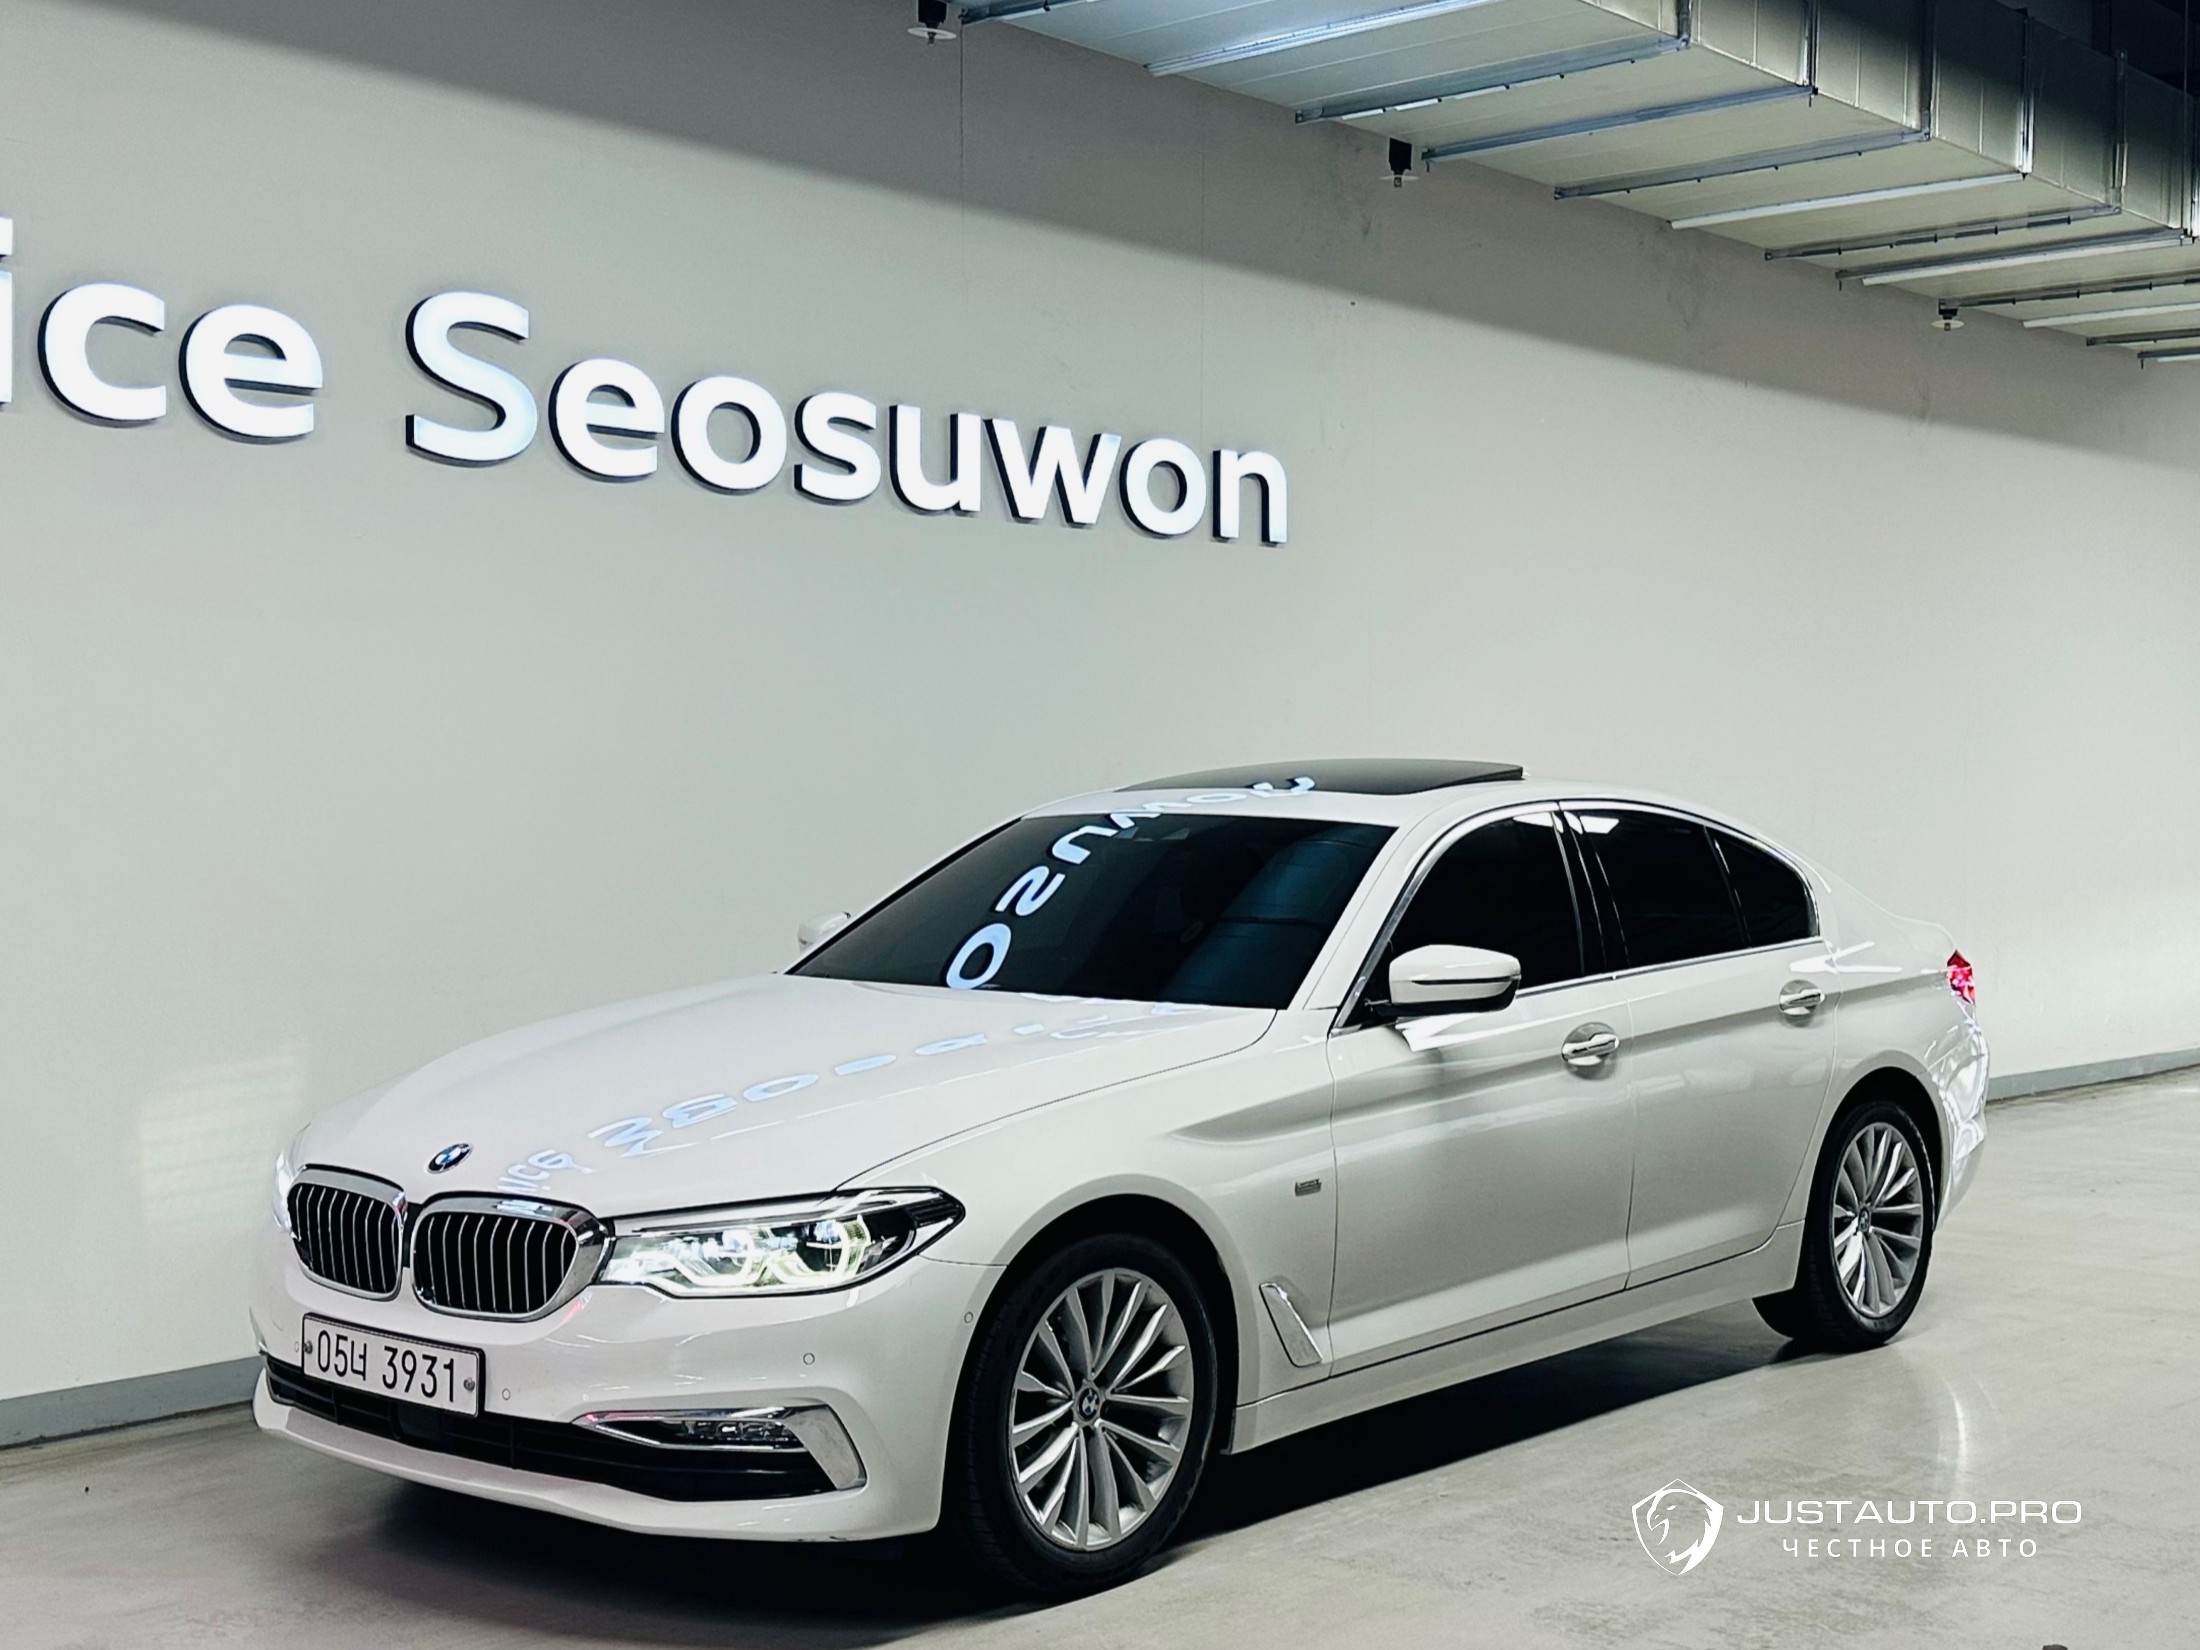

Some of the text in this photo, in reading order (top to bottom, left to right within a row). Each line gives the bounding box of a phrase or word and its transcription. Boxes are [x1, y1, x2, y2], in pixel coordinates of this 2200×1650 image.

[405, 290, 1289, 545] Seosuwon
[317, 1329, 455, 1403] 05너 3931
